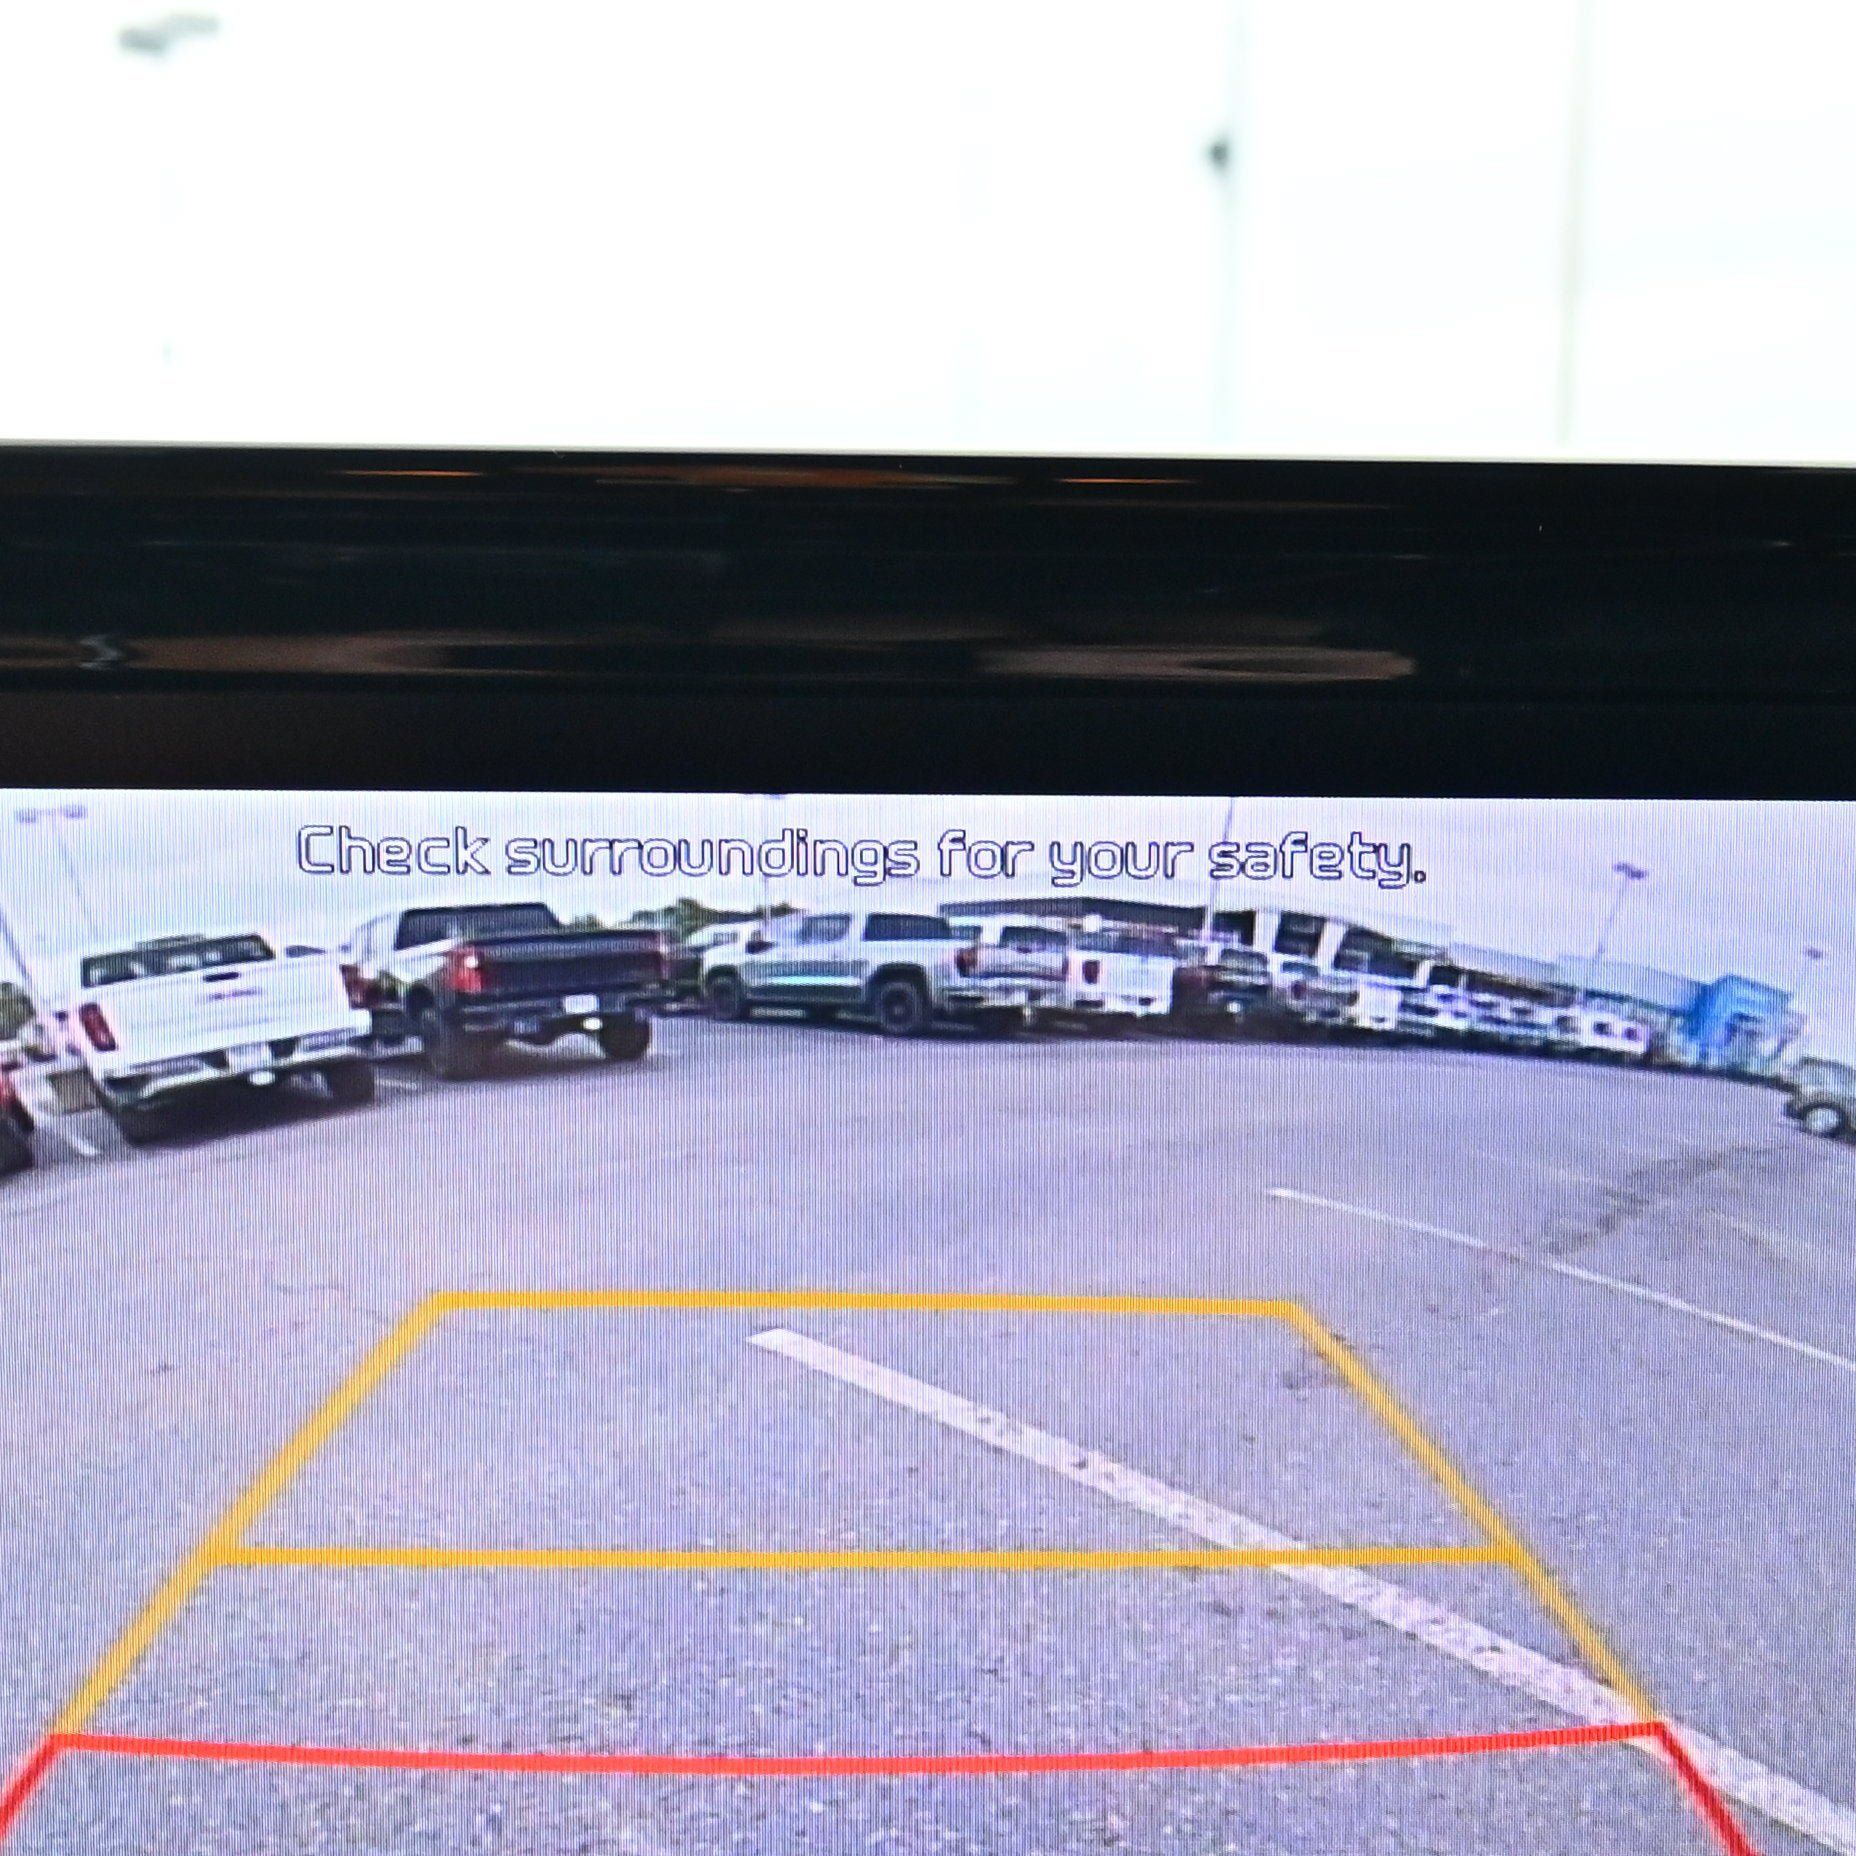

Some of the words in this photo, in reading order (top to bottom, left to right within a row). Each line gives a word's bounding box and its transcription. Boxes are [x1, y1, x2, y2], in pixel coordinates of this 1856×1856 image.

[297, 825, 491, 875] Check
[506, 827, 920, 886] surroundings
[937, 829, 1034, 879] for
[1049, 840, 1194, 887] your
[1209, 831, 1427, 889] safety.
